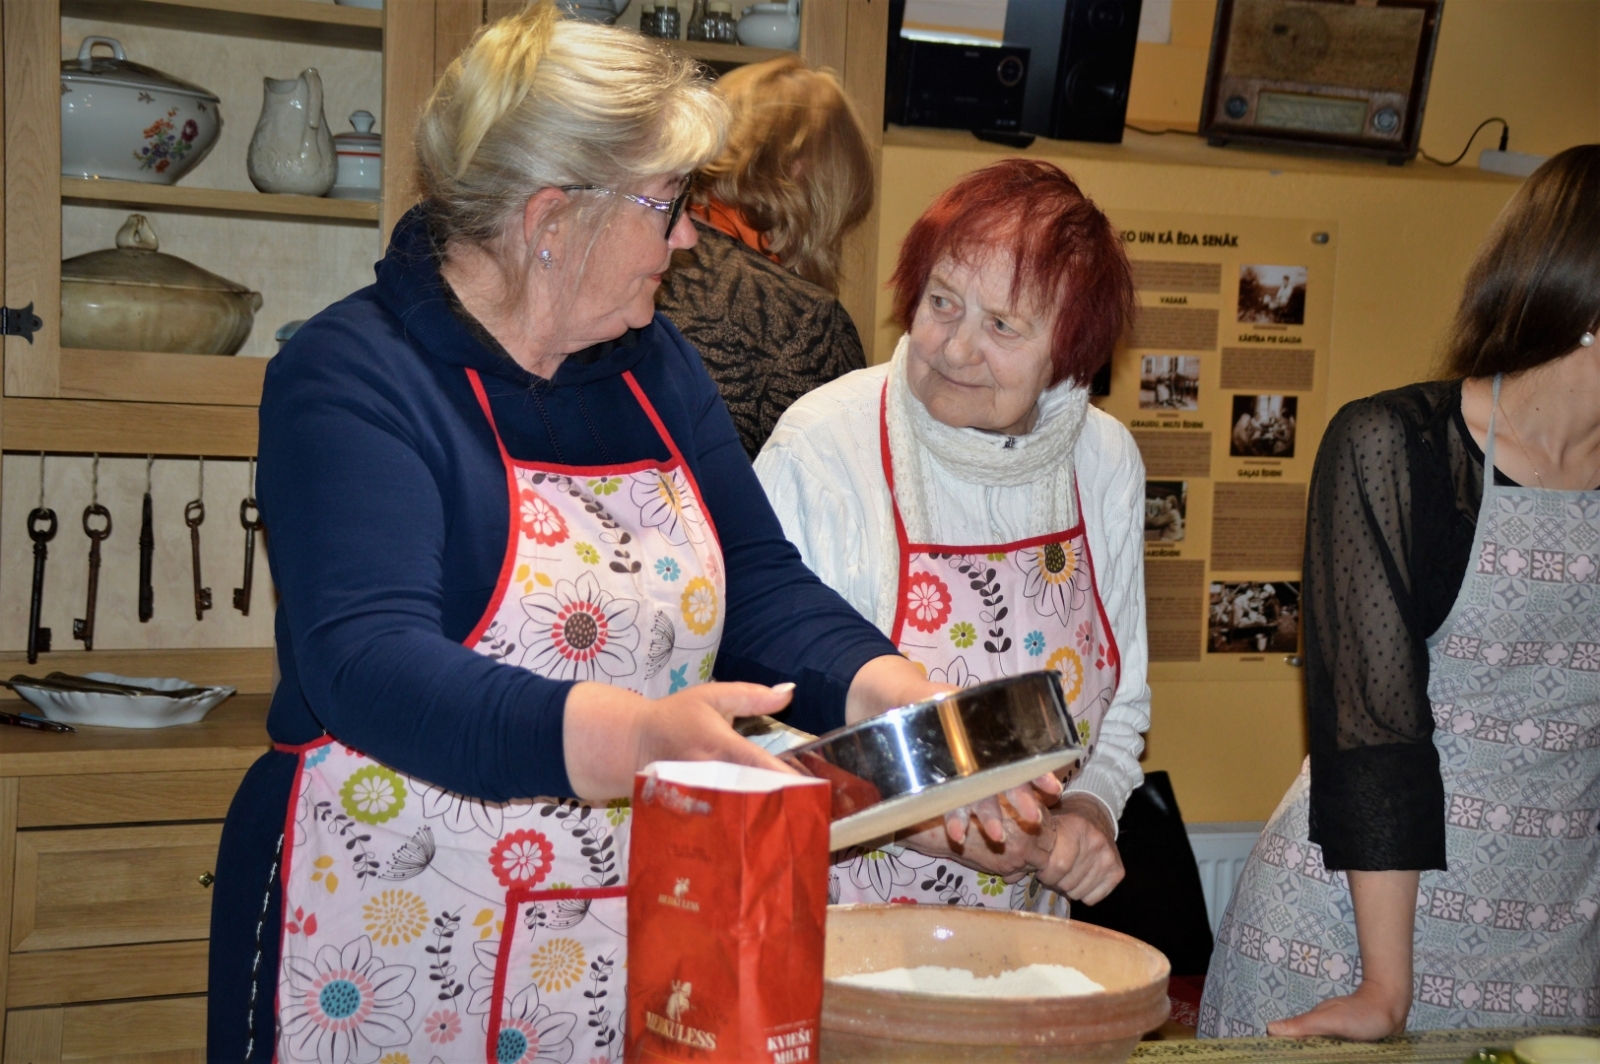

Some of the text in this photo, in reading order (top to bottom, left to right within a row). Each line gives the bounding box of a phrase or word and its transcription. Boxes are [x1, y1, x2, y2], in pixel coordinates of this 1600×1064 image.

[1120, 230, 1239, 247] KO UN KĀ ĒDA SENĀK
[1160, 295, 1188, 305] VASARĀ
[646, 1010, 716, 1051] HERKULESS
[767, 1027, 814, 1052] KVIEŠU
[774, 1044, 809, 1064] MILTI
